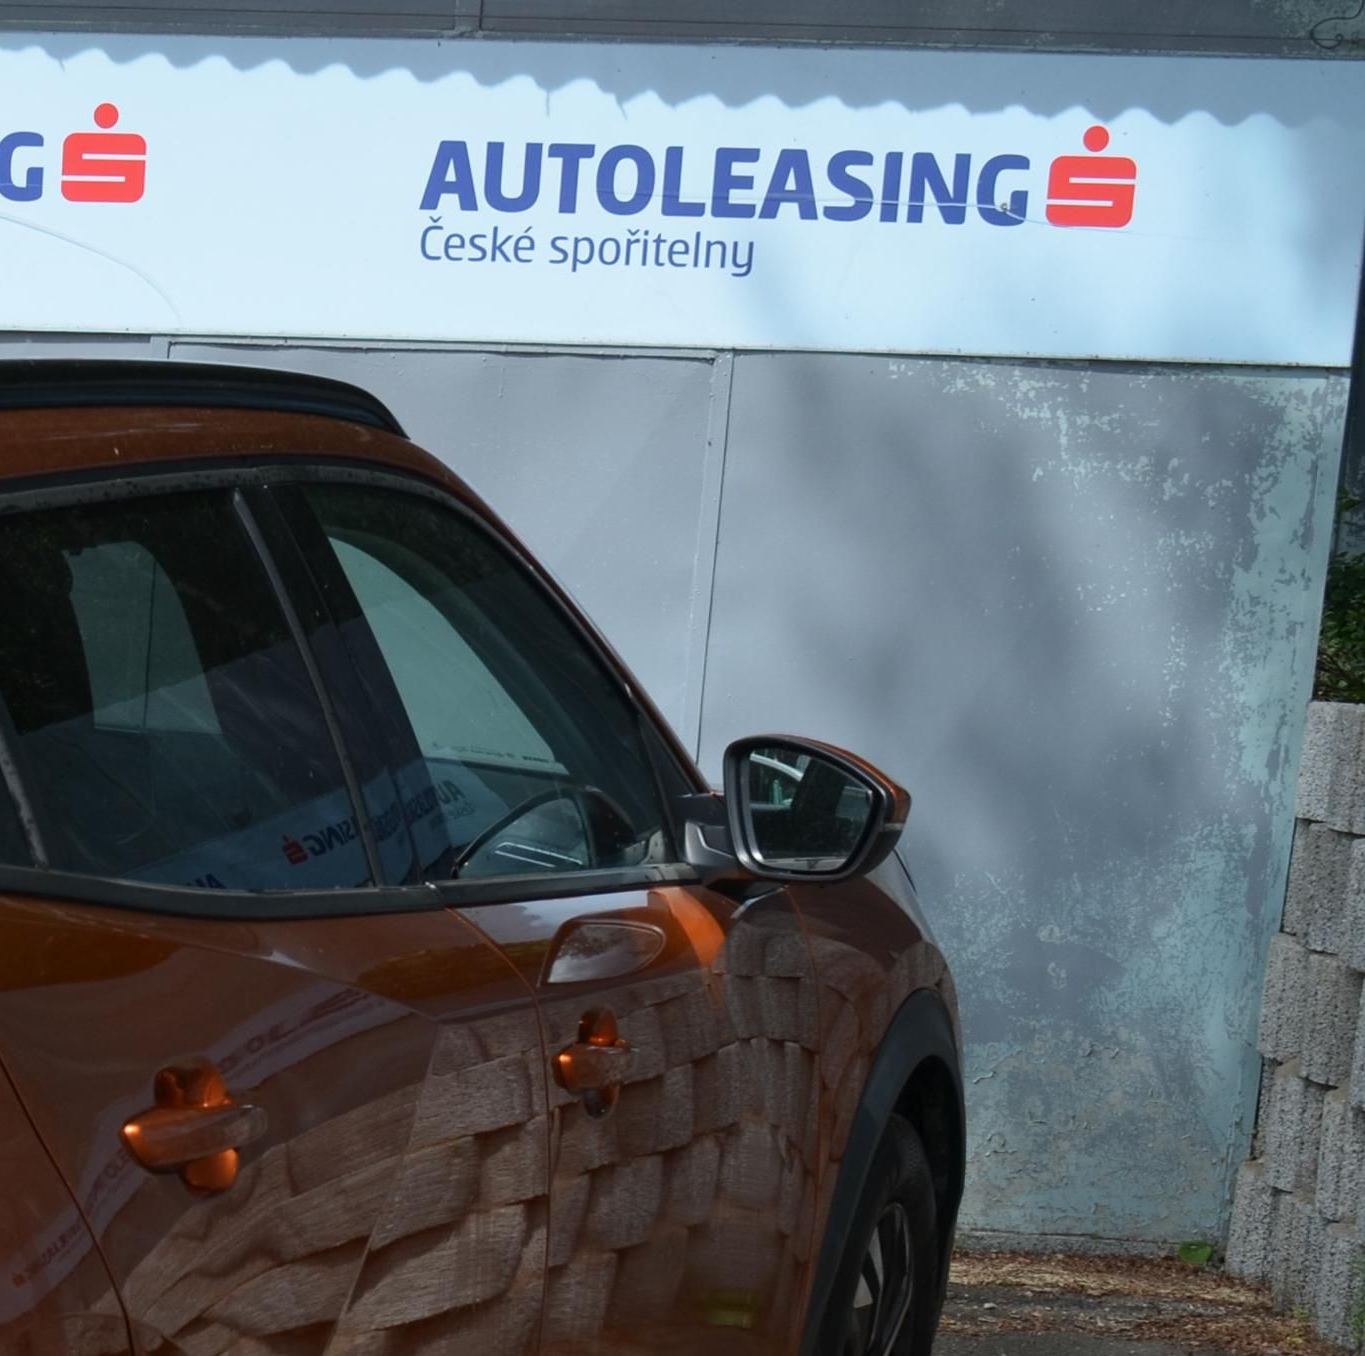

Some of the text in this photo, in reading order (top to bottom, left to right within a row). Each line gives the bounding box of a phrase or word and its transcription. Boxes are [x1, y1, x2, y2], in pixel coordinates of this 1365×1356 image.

[419, 140, 1031, 227] AUTOLEASING
[420, 217, 755, 278] České spořitelny
